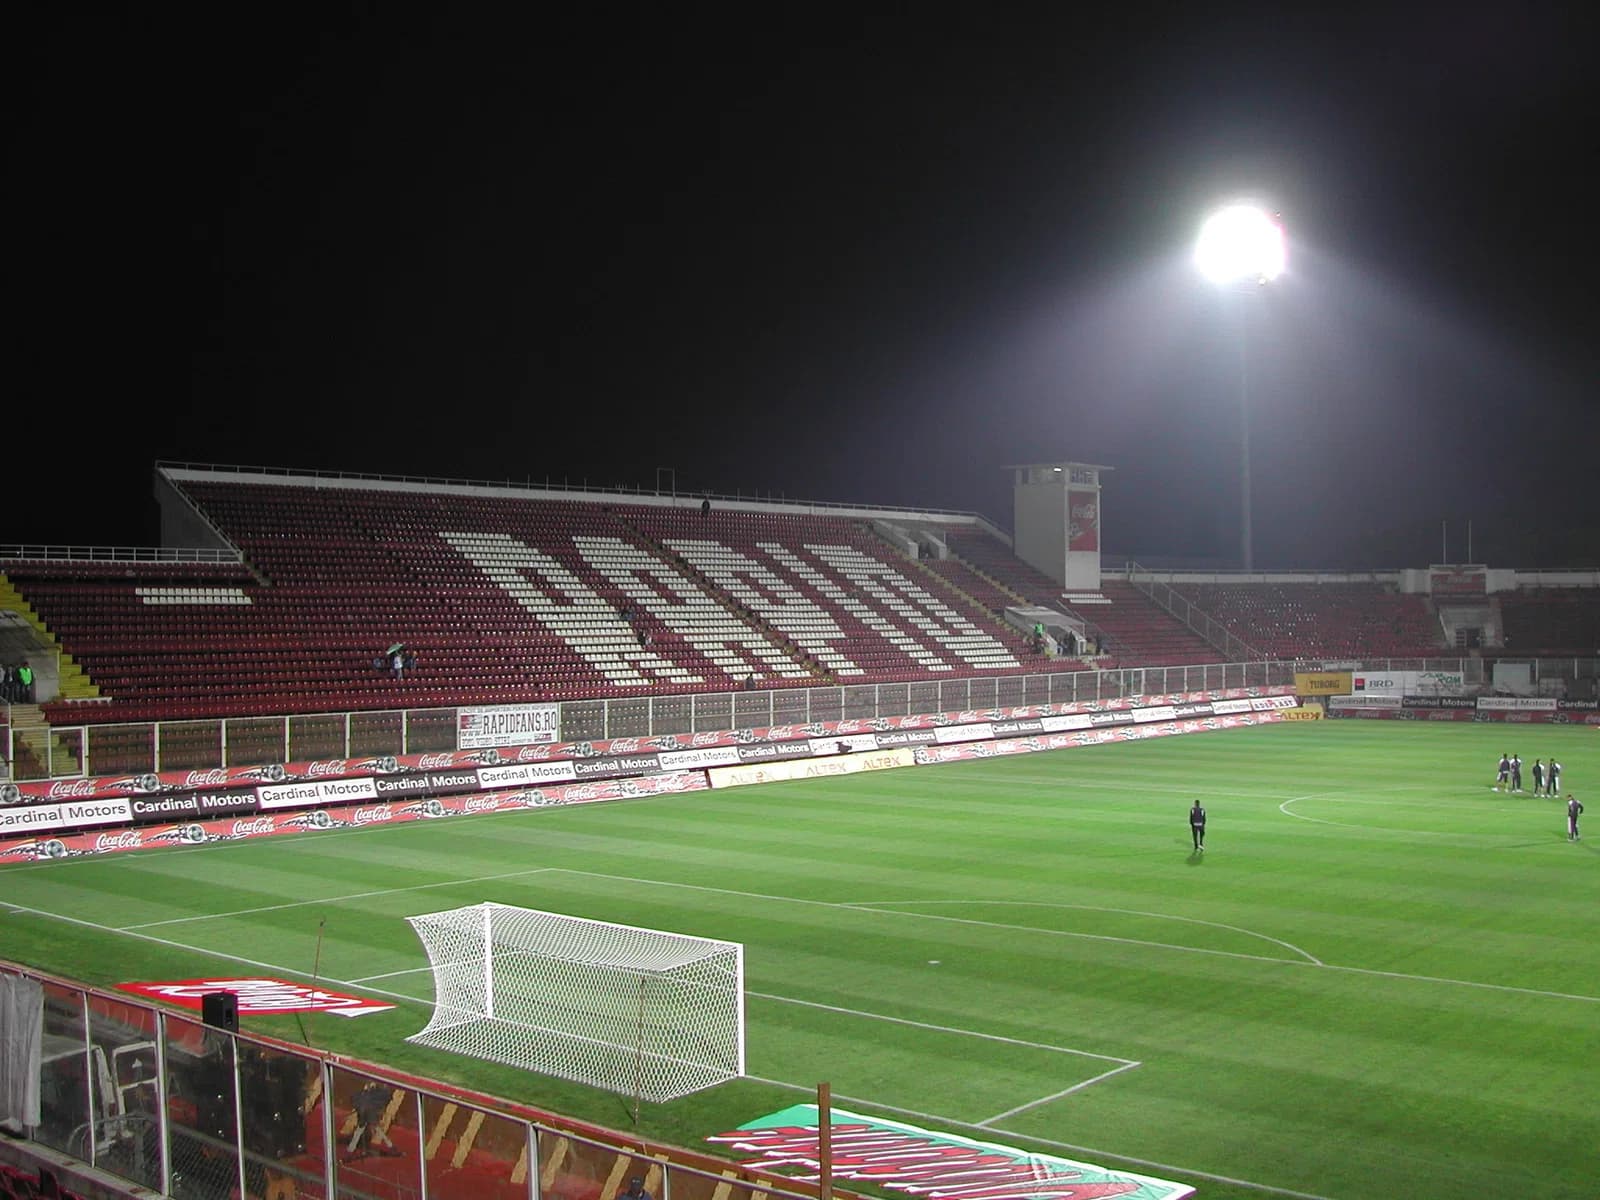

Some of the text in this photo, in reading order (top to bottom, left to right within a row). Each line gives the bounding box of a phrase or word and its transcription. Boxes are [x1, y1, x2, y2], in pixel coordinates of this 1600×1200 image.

[438, 531, 1022, 687] RAPID
[1369, 680, 1394, 688] BRD
[1403, 697, 1475, 707] Cardinal Motors
[1479, 699, 1554, 707] Cardinal Motors
[1558, 700, 1598, 708] Cardinal
[877, 732, 936, 744] Cardinal Motors
[662, 751, 737, 765] Cardinal Motors
[739, 744, 809, 758] Cardinal Motors
[575, 758, 658, 773] Cardinal Motors
[481, 766, 572, 782] Cardinal Motors
[376, 775, 477, 791] Cardinal Motors
[262, 783, 372, 801] Cardinal Motors
[133, 794, 256, 813] Cardinal Motors
[69, 805, 126, 819] Motors
